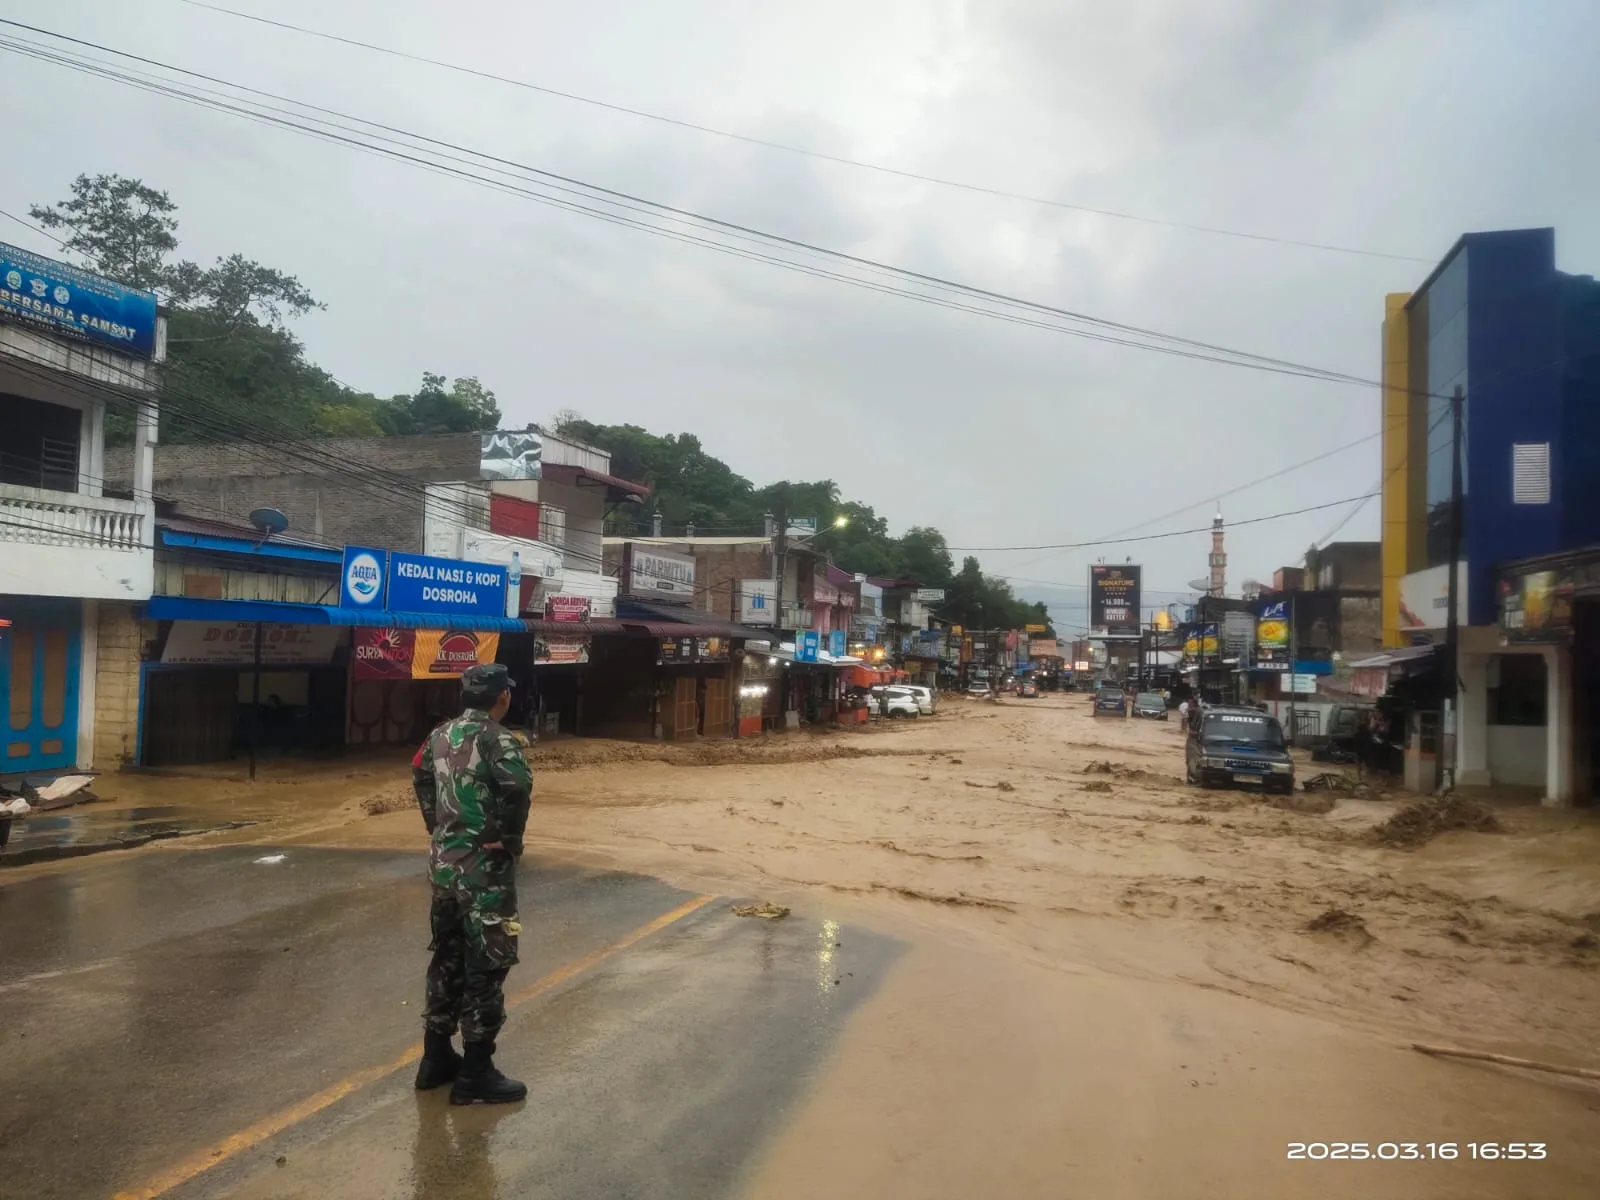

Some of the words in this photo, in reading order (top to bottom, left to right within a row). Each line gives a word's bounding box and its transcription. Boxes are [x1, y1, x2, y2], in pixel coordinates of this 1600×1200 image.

[81, 314, 137, 341] SAMSAT
[352, 565, 377, 582] AQUA
[398, 562, 434, 580] KEDAI
[437, 568, 464, 583] NASI
[466, 570, 473, 582] &
[475, 572, 500, 587] KOPI
[423, 587, 478, 604] DOSROHA
[1222, 715, 1264, 724] SMILE
